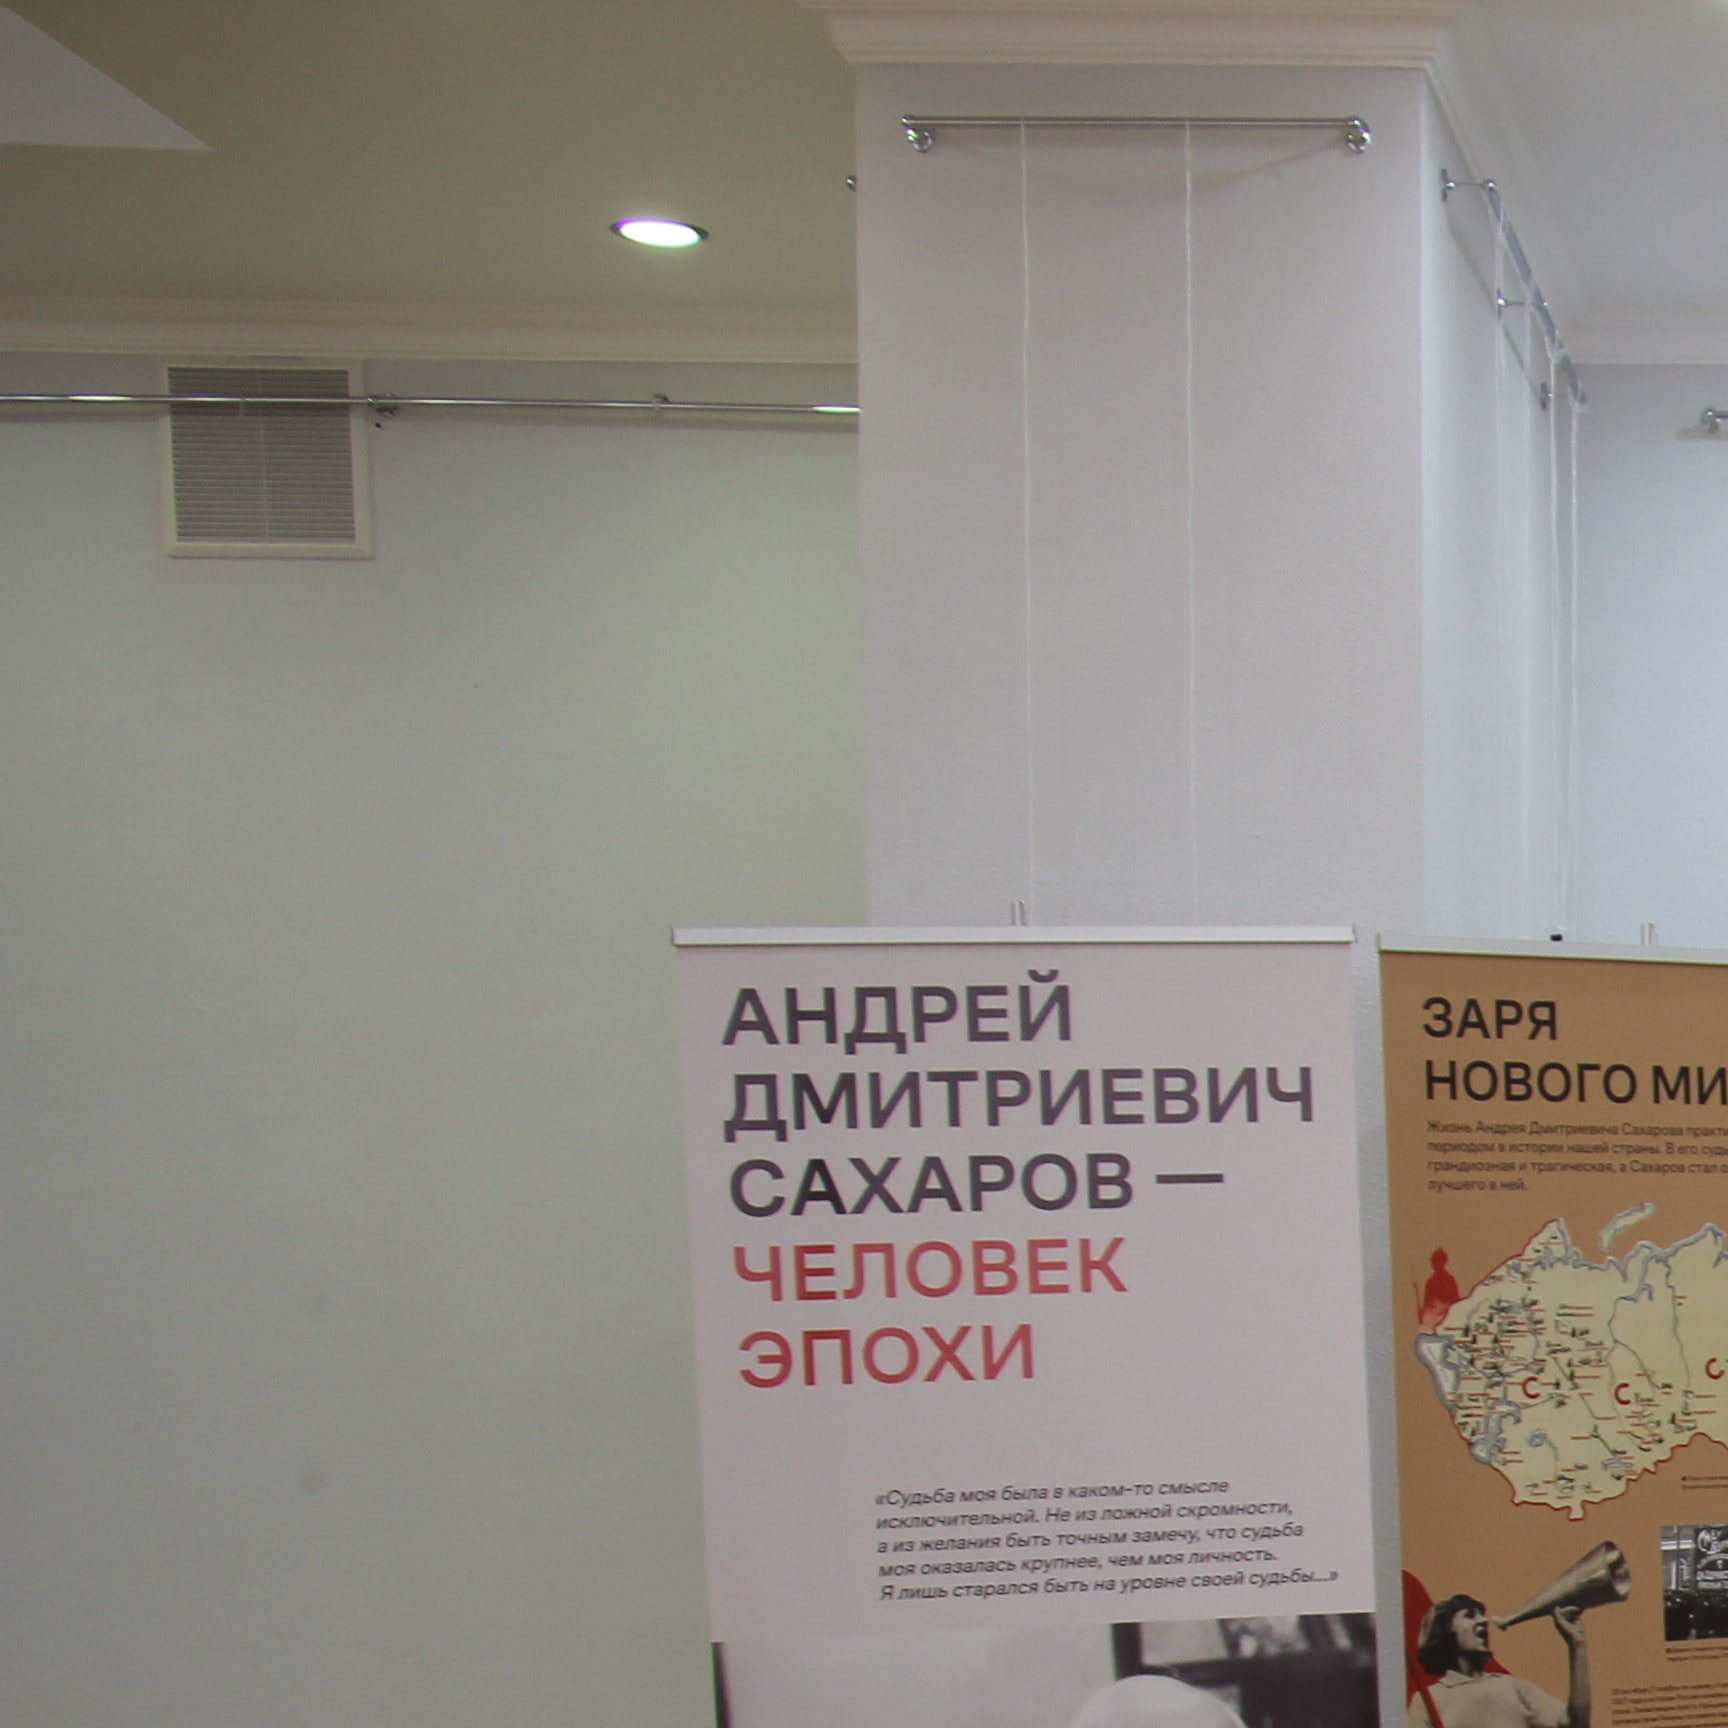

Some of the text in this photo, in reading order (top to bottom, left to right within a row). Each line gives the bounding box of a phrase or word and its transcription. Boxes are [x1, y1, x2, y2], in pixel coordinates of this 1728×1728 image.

[722, 969, 1071, 1055] АНДРЕЙ
[1423, 996, 1557, 1041] ЗАРЯ
[1425, 1059, 1637, 1104] НОВОГО
[724, 1067, 1312, 1142] ДМИТРИЕВИЧ
[730, 1153, 1133, 1217] САХАРОВ
[734, 1237, 1127, 1302] ЧЕЛОВЕК
[739, 1324, 1034, 1388] ЭПОХИ
[874, 1482, 1229, 1508] «Судьба моя была в каком-то смысле
[875, 1504, 1292, 1529] исключительной. Не из ложной скромности,
[876, 1522, 1304, 1553] а из желания быть точным замечу, что судьба
[878, 1550, 1276, 1577] моя оказалась крупнее, чем моя личность.
[879, 1584, 894, 1599] Я
[897, 1586, 948, 1599] лишь
[951, 1583, 1040, 1601] старался
[1042, 1577, 1089, 1593] быть
[1092, 1580, 1116, 1591] на
[1120, 1577, 1187, 1594] уровне
[1190, 1571, 1245, 1587] своей
